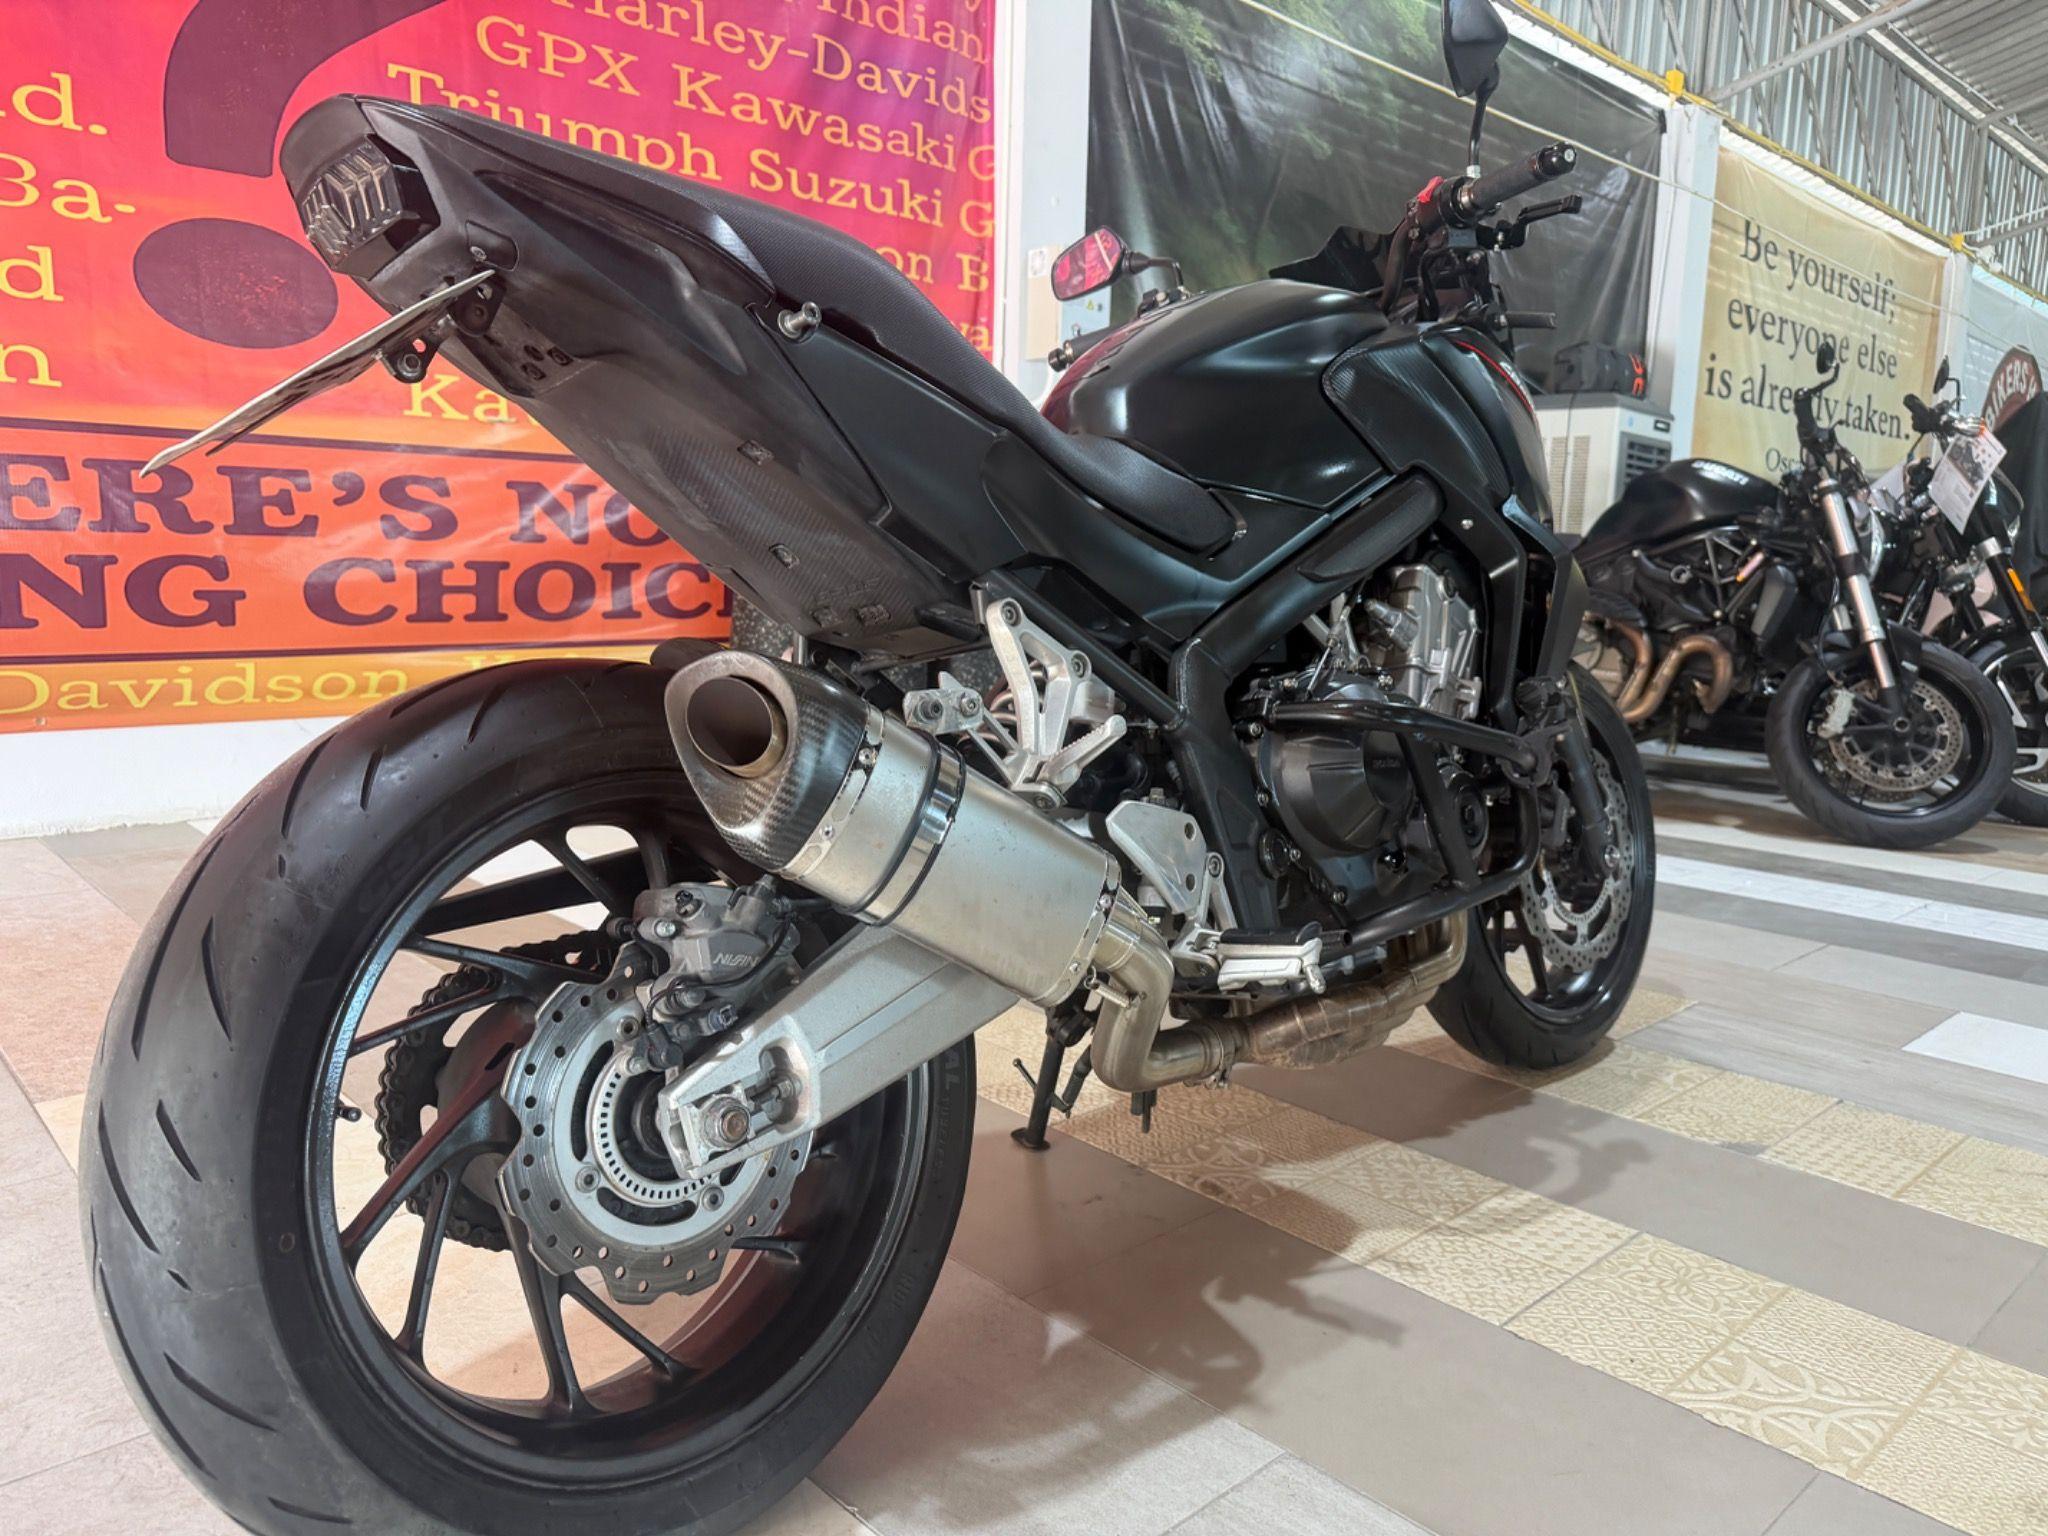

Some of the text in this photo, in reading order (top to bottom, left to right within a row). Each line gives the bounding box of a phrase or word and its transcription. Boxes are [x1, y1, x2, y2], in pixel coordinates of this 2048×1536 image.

[0, 72, 108, 135] d.
[476, 15, 640, 97] GPX
[672, 63, 957, 173] Kawasaki
[387, 63, 722, 181] Triumph
[750, 148, 944, 228] Suzuki
[1740, 219, 1896, 324] Be yourself;
[1728, 298, 1898, 379] everyone else
[403, 374, 540, 427] Ka
[1704, 353, 1910, 440] is alrey taken.
[303, 557, 734, 627] CHOIC
[0, 662, 409, 715] Davidson
